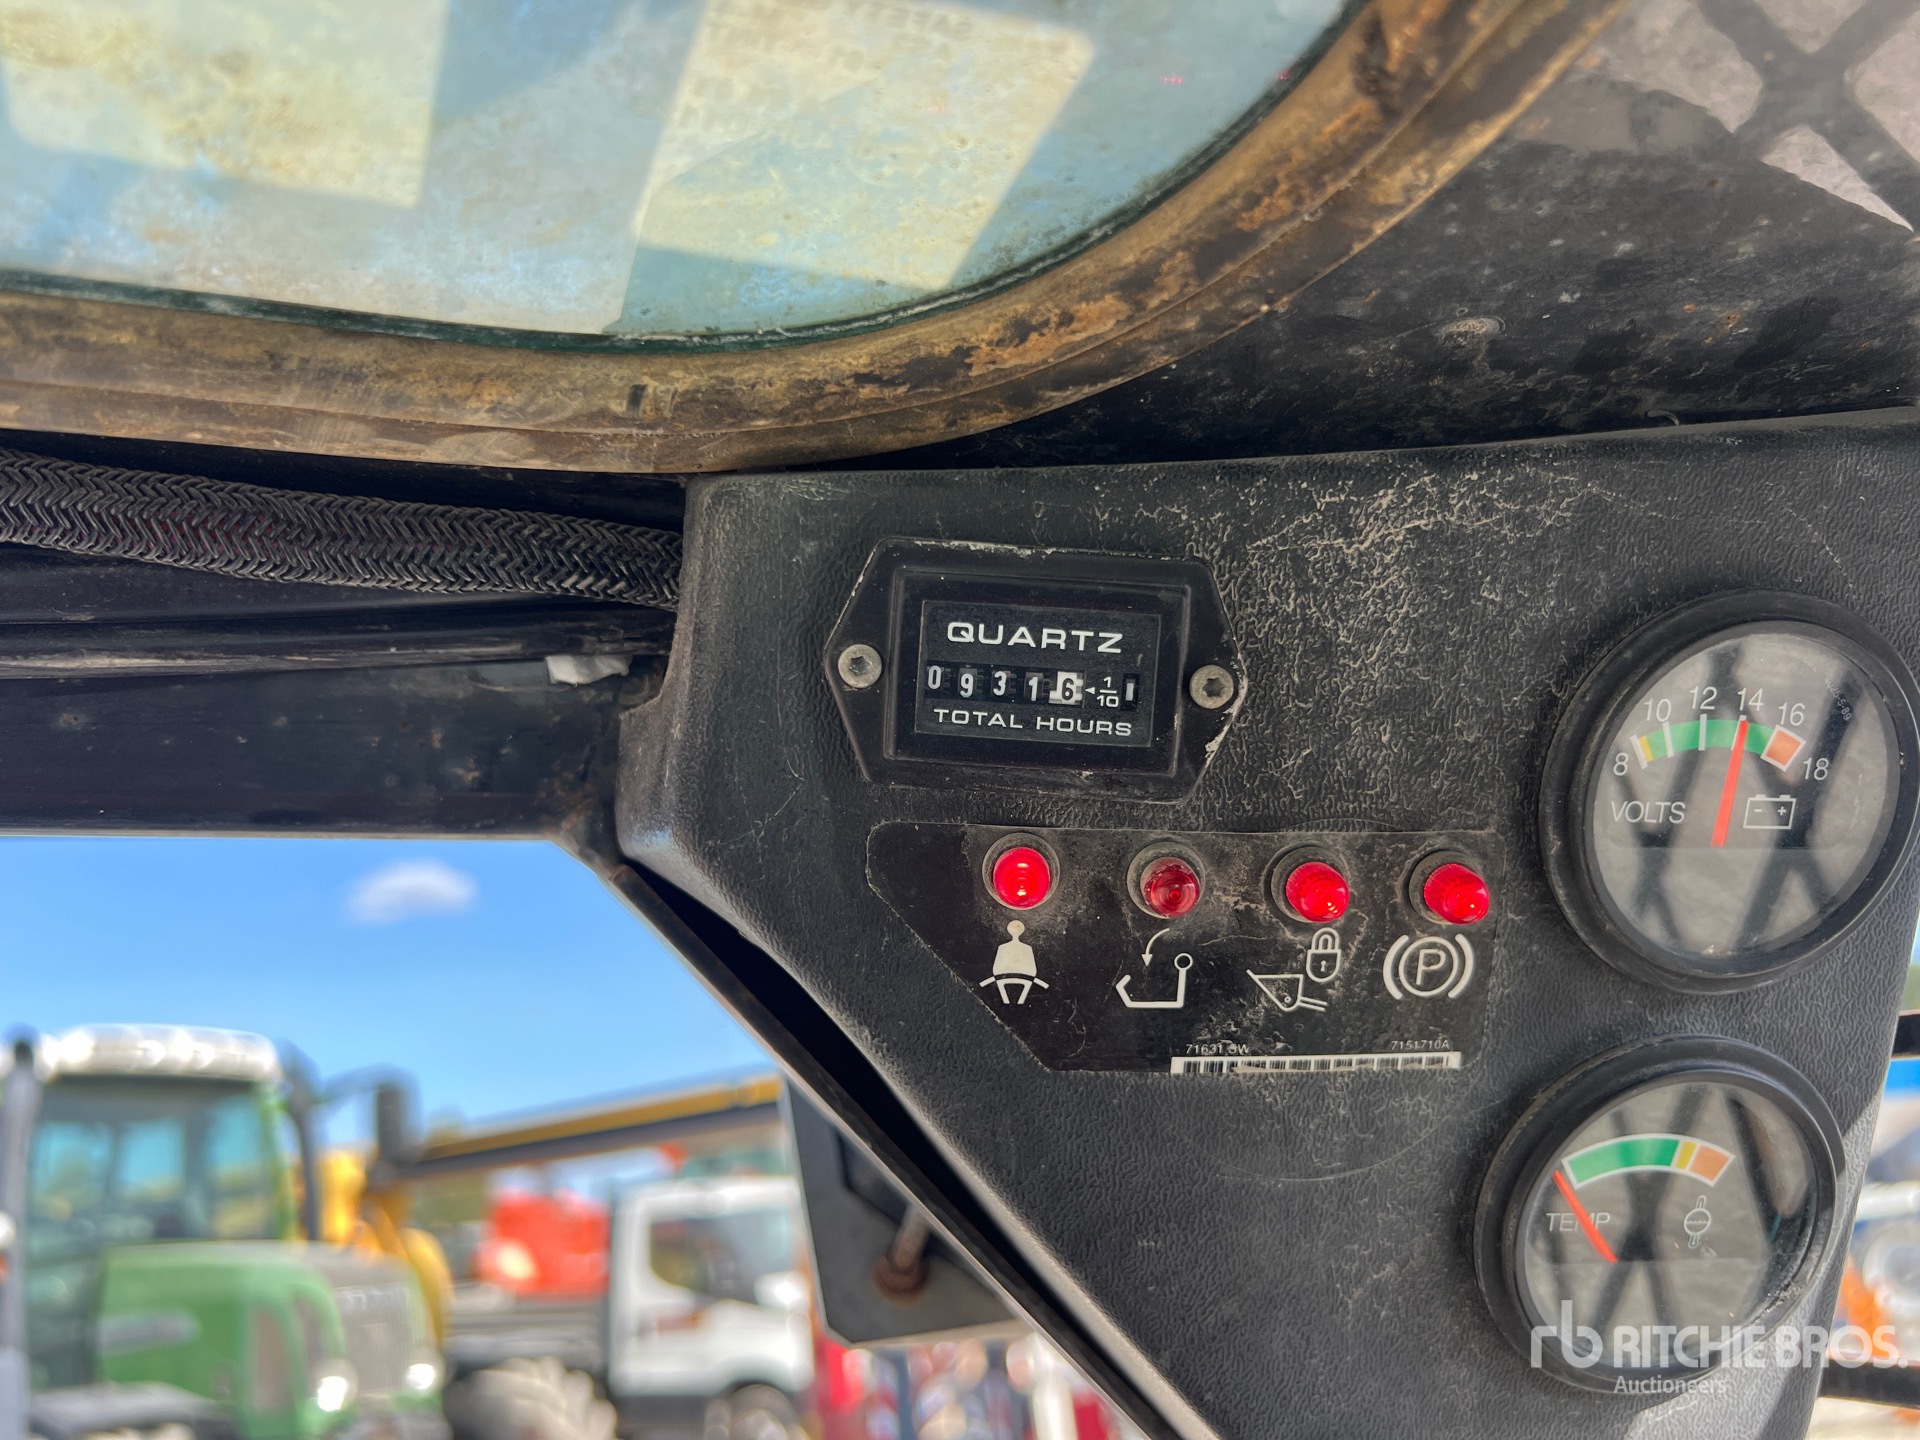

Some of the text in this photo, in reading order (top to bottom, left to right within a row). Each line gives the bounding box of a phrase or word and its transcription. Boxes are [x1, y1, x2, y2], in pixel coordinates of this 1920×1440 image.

[947, 622, 1123, 654] QUARTZ
[1644, 698, 1672, 722] 10
[1690, 686, 1717, 710] 12
[1737, 687, 1764, 711] 14
[934, 708, 1132, 736] TOTAL HOURS
[1778, 702, 1805, 726] 16
[1613, 752, 1629, 776] 8
[1803, 757, 1829, 780] 18
[1611, 800, 1686, 824] VOLTS
[1391, 1039, 1450, 1051] 7151710A
